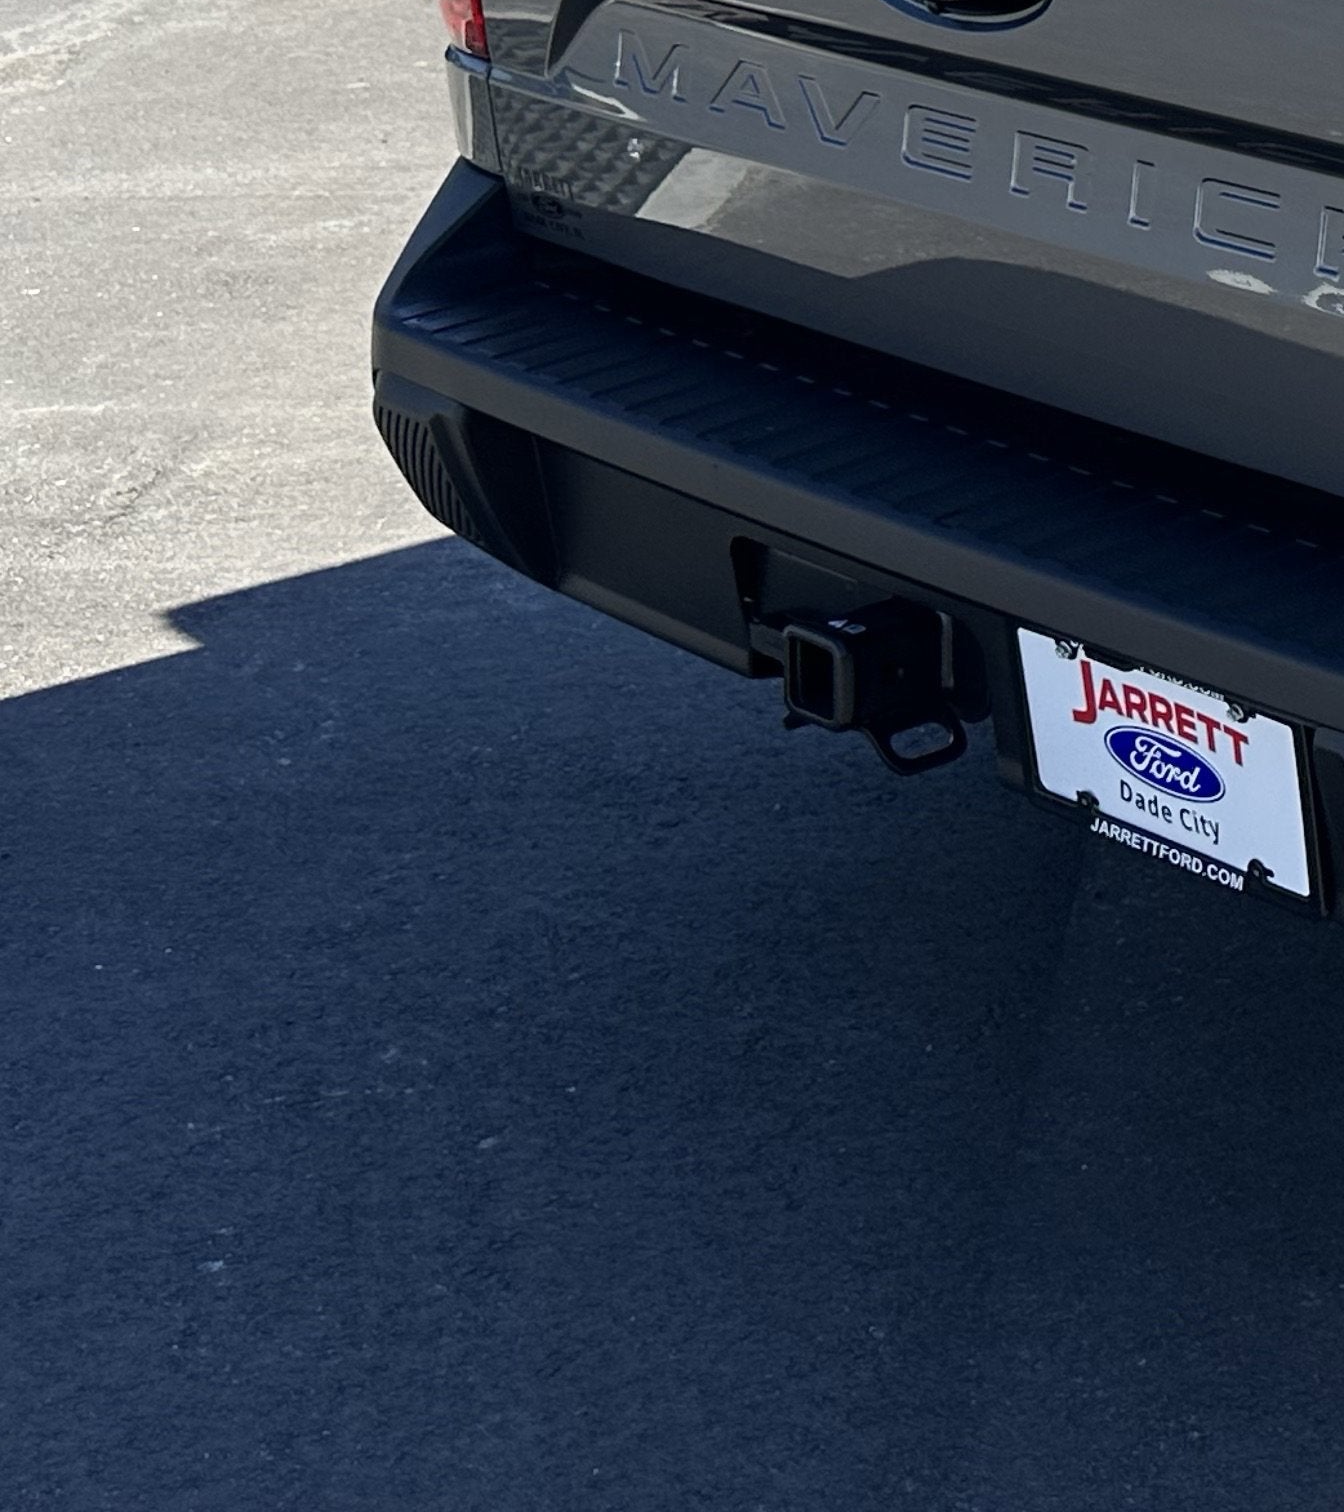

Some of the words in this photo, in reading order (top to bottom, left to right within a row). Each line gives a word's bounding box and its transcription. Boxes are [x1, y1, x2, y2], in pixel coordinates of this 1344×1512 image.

[1072, 659, 1250, 767] JARRETT
[1129, 736, 1202, 793] Ford
[1120, 779, 1173, 824] Dade
[1179, 808, 1220, 846] City
[1090, 817, 1244, 892] JARRETTFORD.COM
